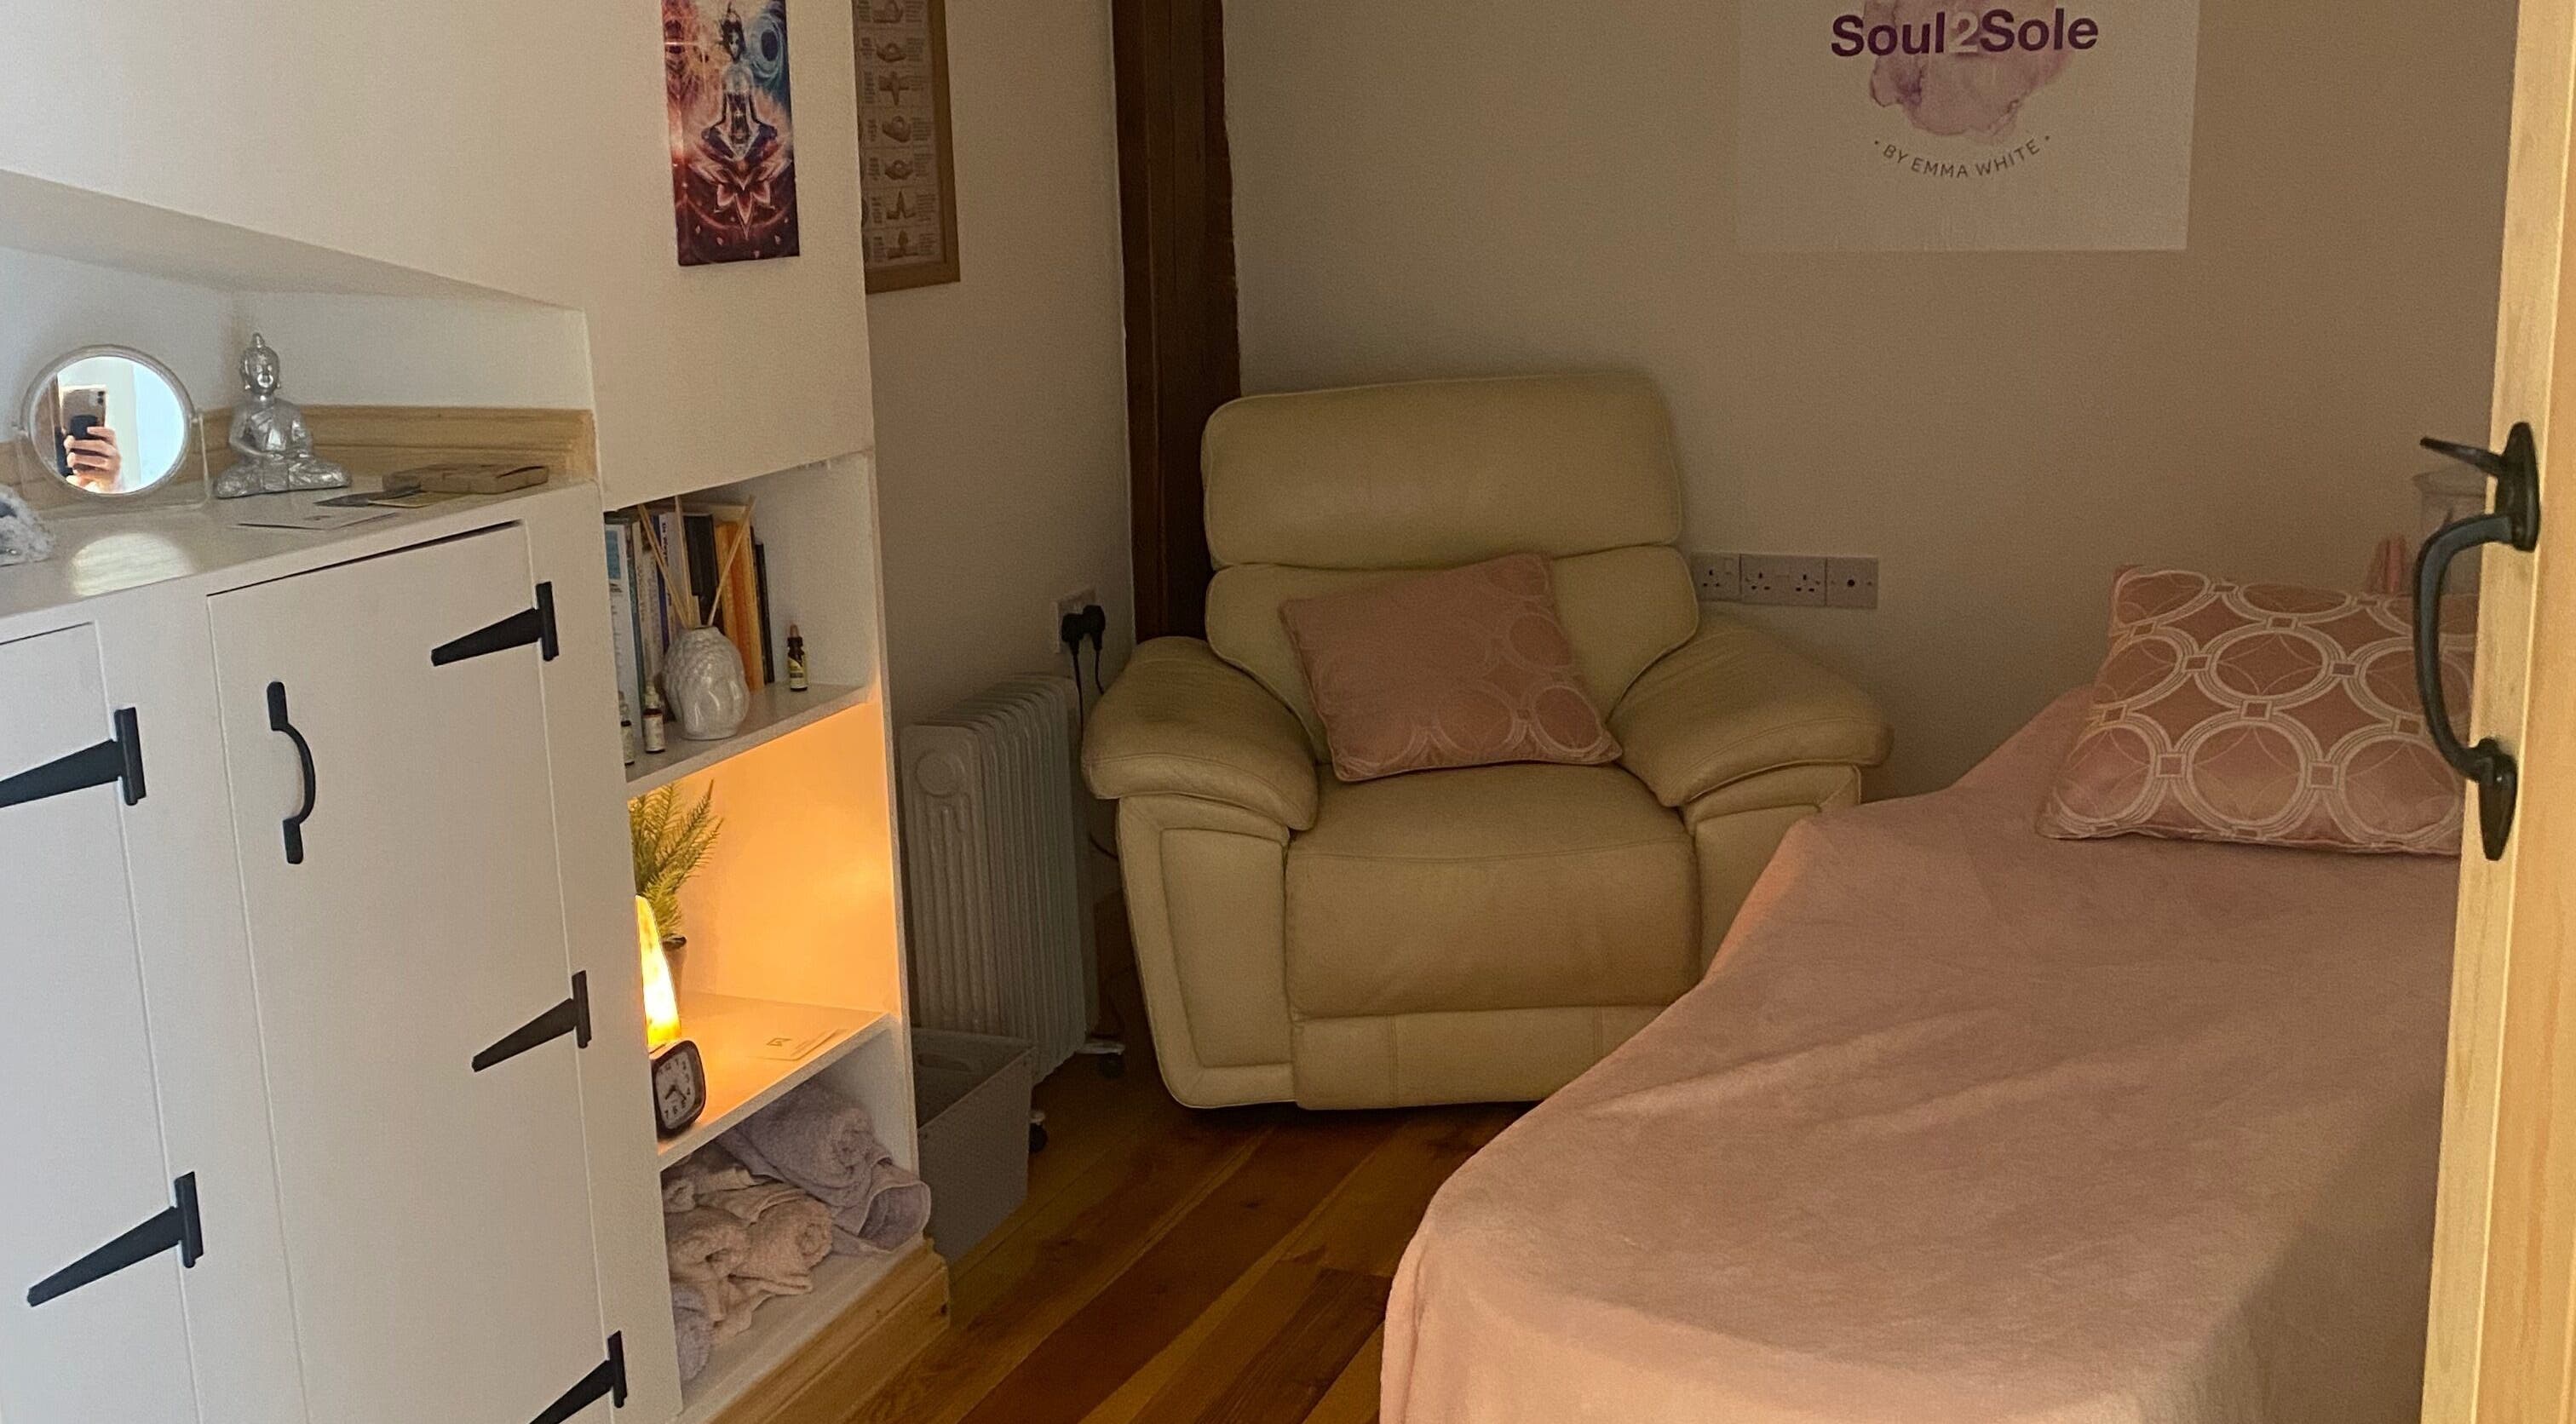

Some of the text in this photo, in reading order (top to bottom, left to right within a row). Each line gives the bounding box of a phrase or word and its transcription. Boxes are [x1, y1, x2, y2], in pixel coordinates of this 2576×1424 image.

[1831, 8, 2099, 57] Soul2Sole
[1883, 138, 2041, 178] BY EMMA WHITE
